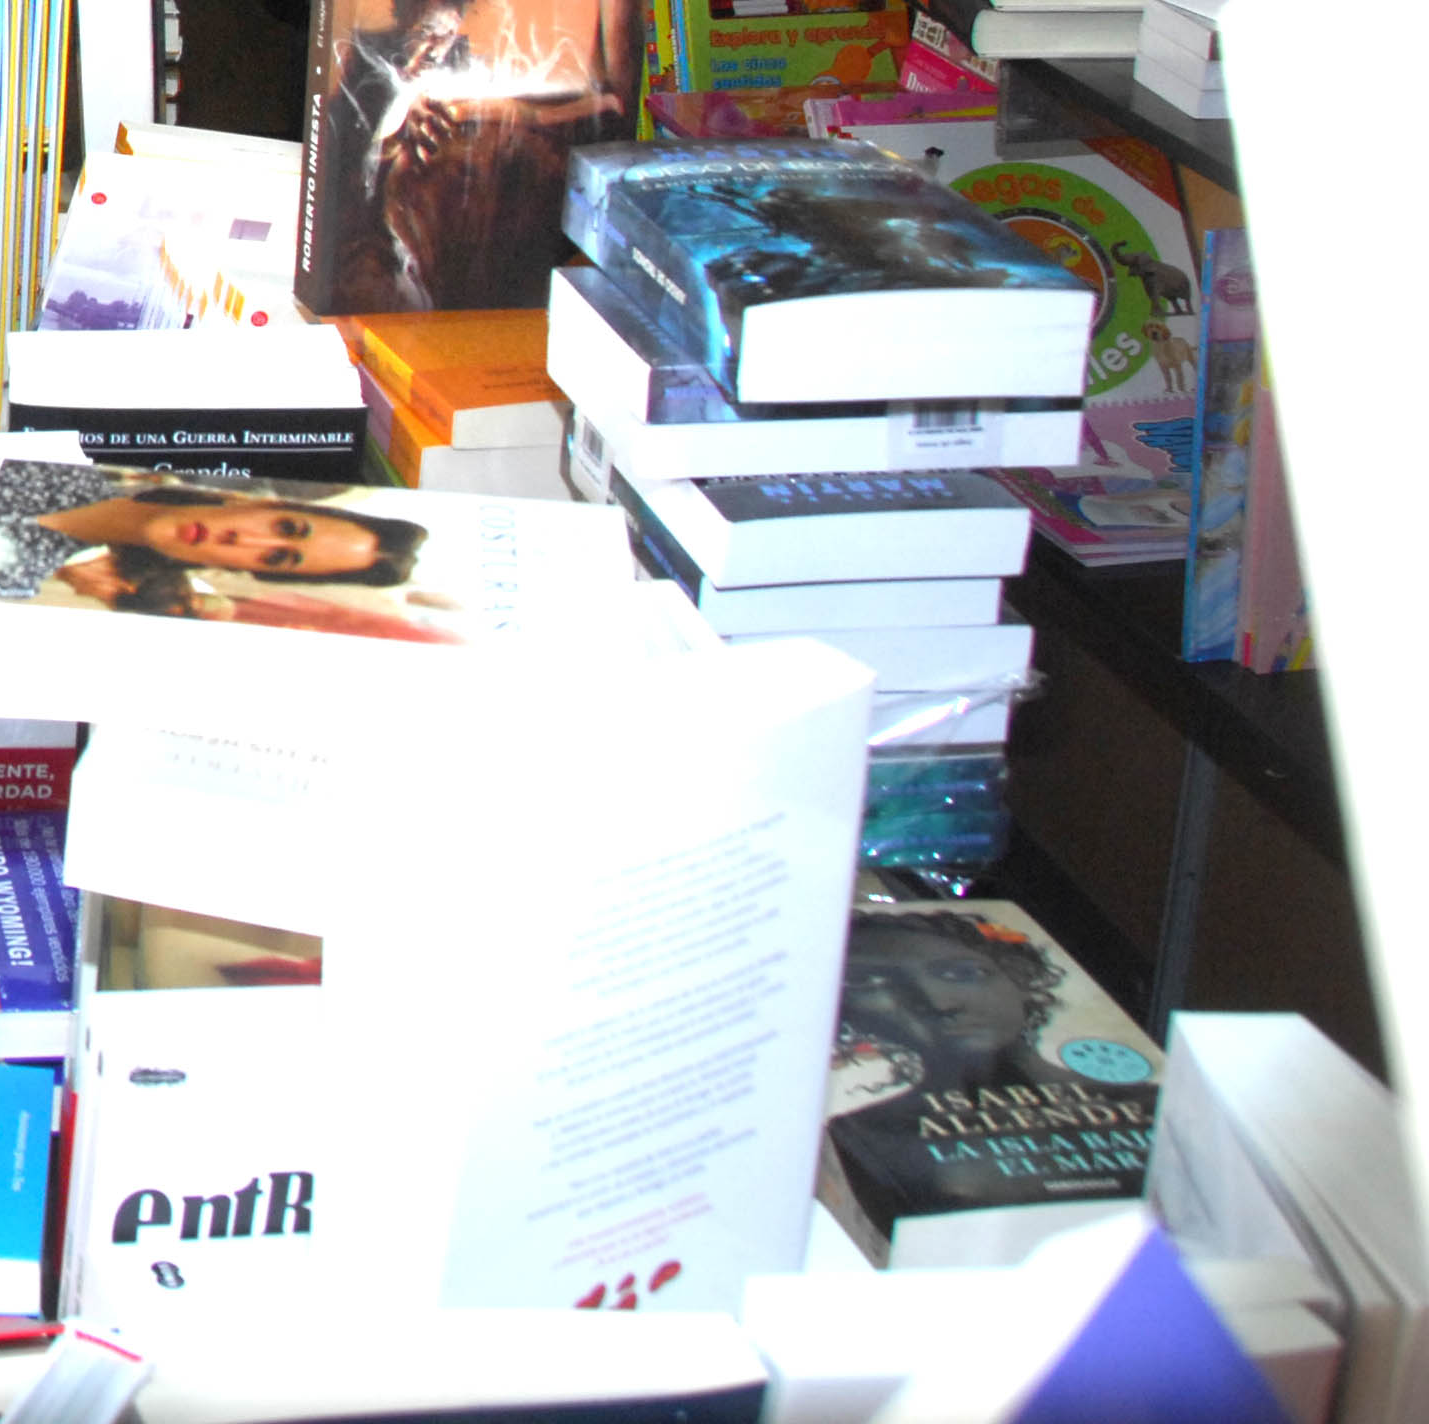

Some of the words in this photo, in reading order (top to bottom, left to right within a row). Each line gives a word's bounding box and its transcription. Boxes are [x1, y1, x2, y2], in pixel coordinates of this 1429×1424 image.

[710, 26, 783, 51] Explora
[786, 29, 799, 49] y
[309, 92, 324, 173] INIESTA
[302, 175, 318, 273] ROBERTO
[110, 432, 131, 445] DE
[135, 432, 168, 445] UNA
[172, 430, 238, 446] GUERRA
[242, 430, 354, 445] INTERMINABLE
[921, 1082, 1107, 1113] ISABEL
[918, 1102, 1154, 1139] ALLENDE
[927, 1141, 981, 1164] LA
[985, 1133, 1077, 1158] ISLA
[996, 1156, 1053, 1178] EL
[1052, 1150, 1145, 1173] MAR
